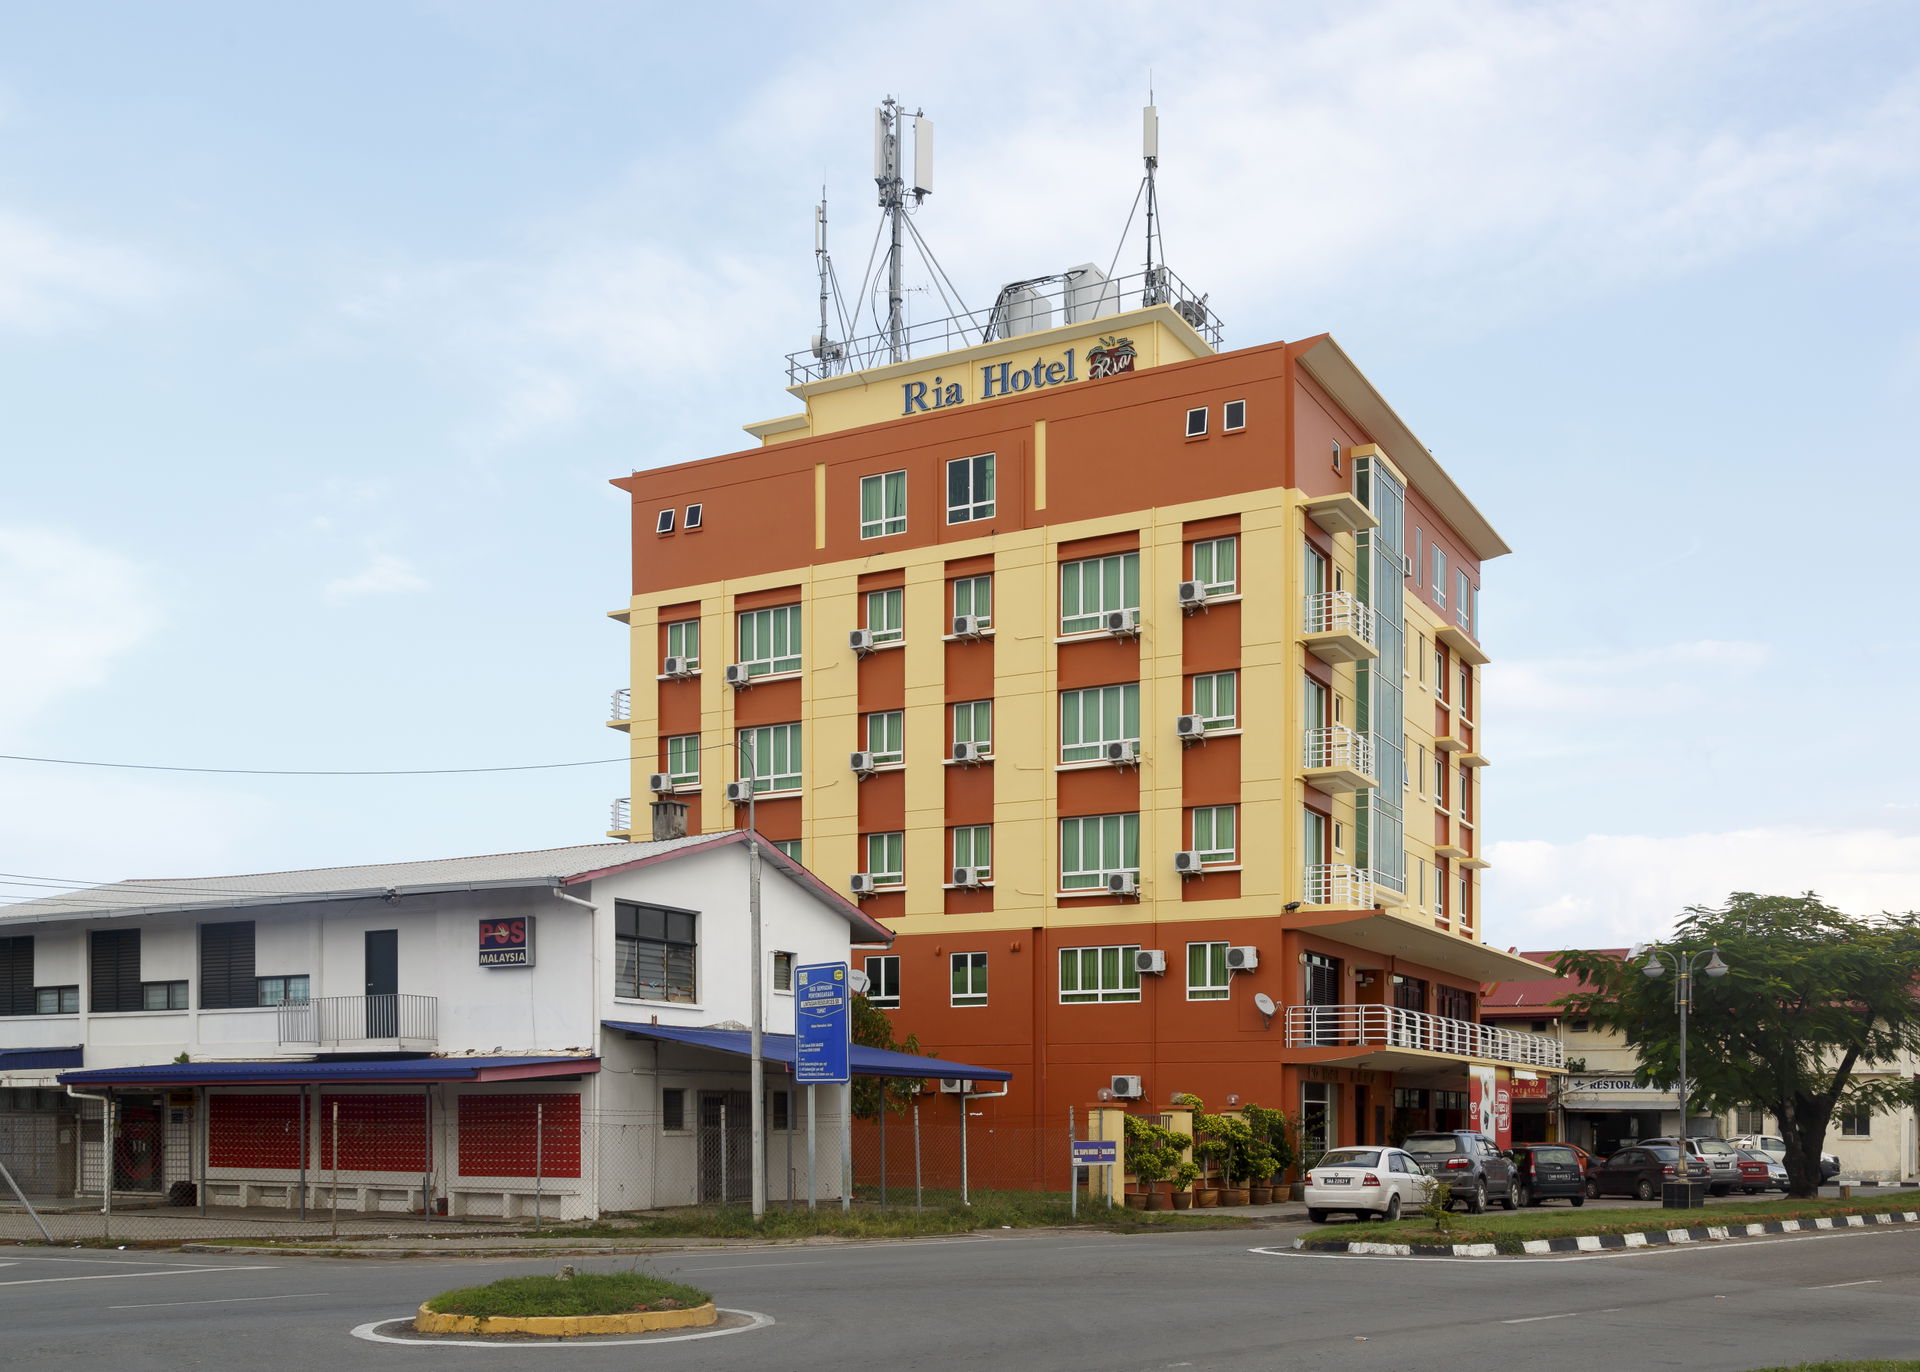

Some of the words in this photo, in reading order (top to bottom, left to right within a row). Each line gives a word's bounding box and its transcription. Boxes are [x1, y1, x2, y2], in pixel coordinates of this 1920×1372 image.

[1087, 352, 1134, 380] Ria
[902, 376, 964, 416] Ria
[980, 348, 1079, 400] Hotel
[480, 921, 526, 945] POS
[480, 952, 526, 964] MALAYSIA
[1590, 1080, 1647, 1090] RESTORA
